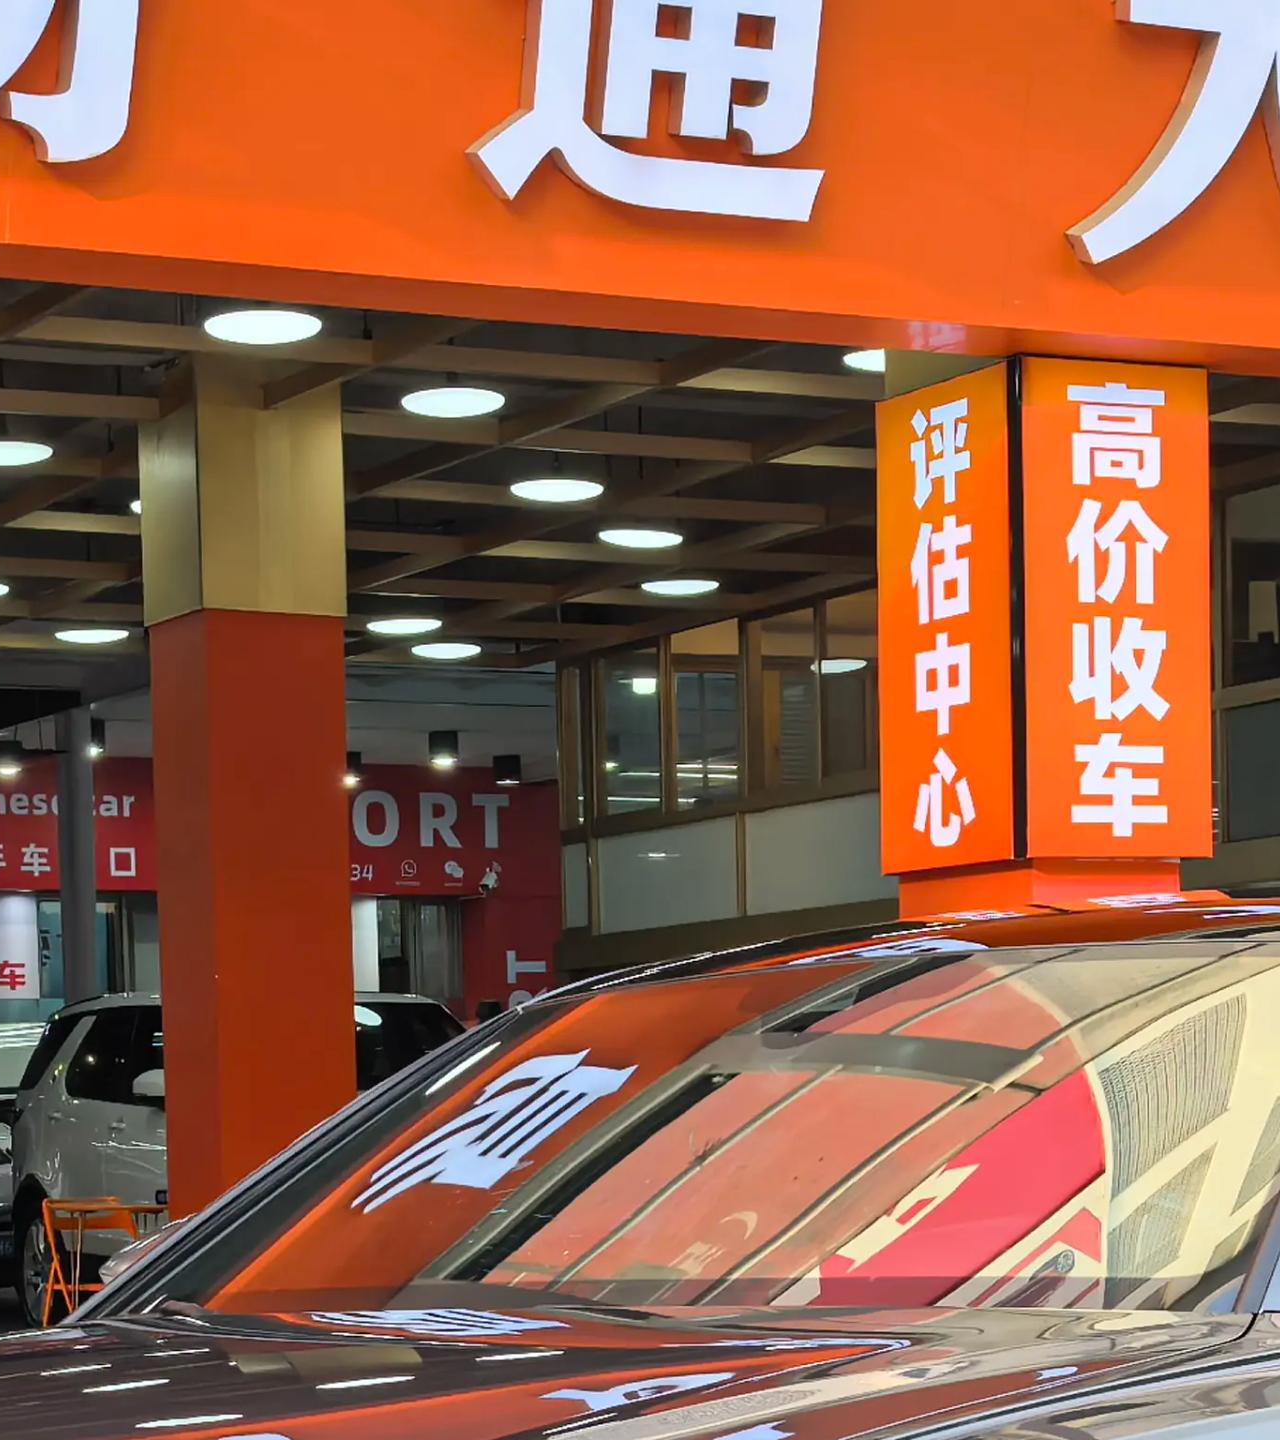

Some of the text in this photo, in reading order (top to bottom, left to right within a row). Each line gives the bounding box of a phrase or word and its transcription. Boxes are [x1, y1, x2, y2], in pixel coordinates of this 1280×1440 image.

[910, 397, 975, 848] 评估中心
[1066, 381, 1171, 838] 高价收车
